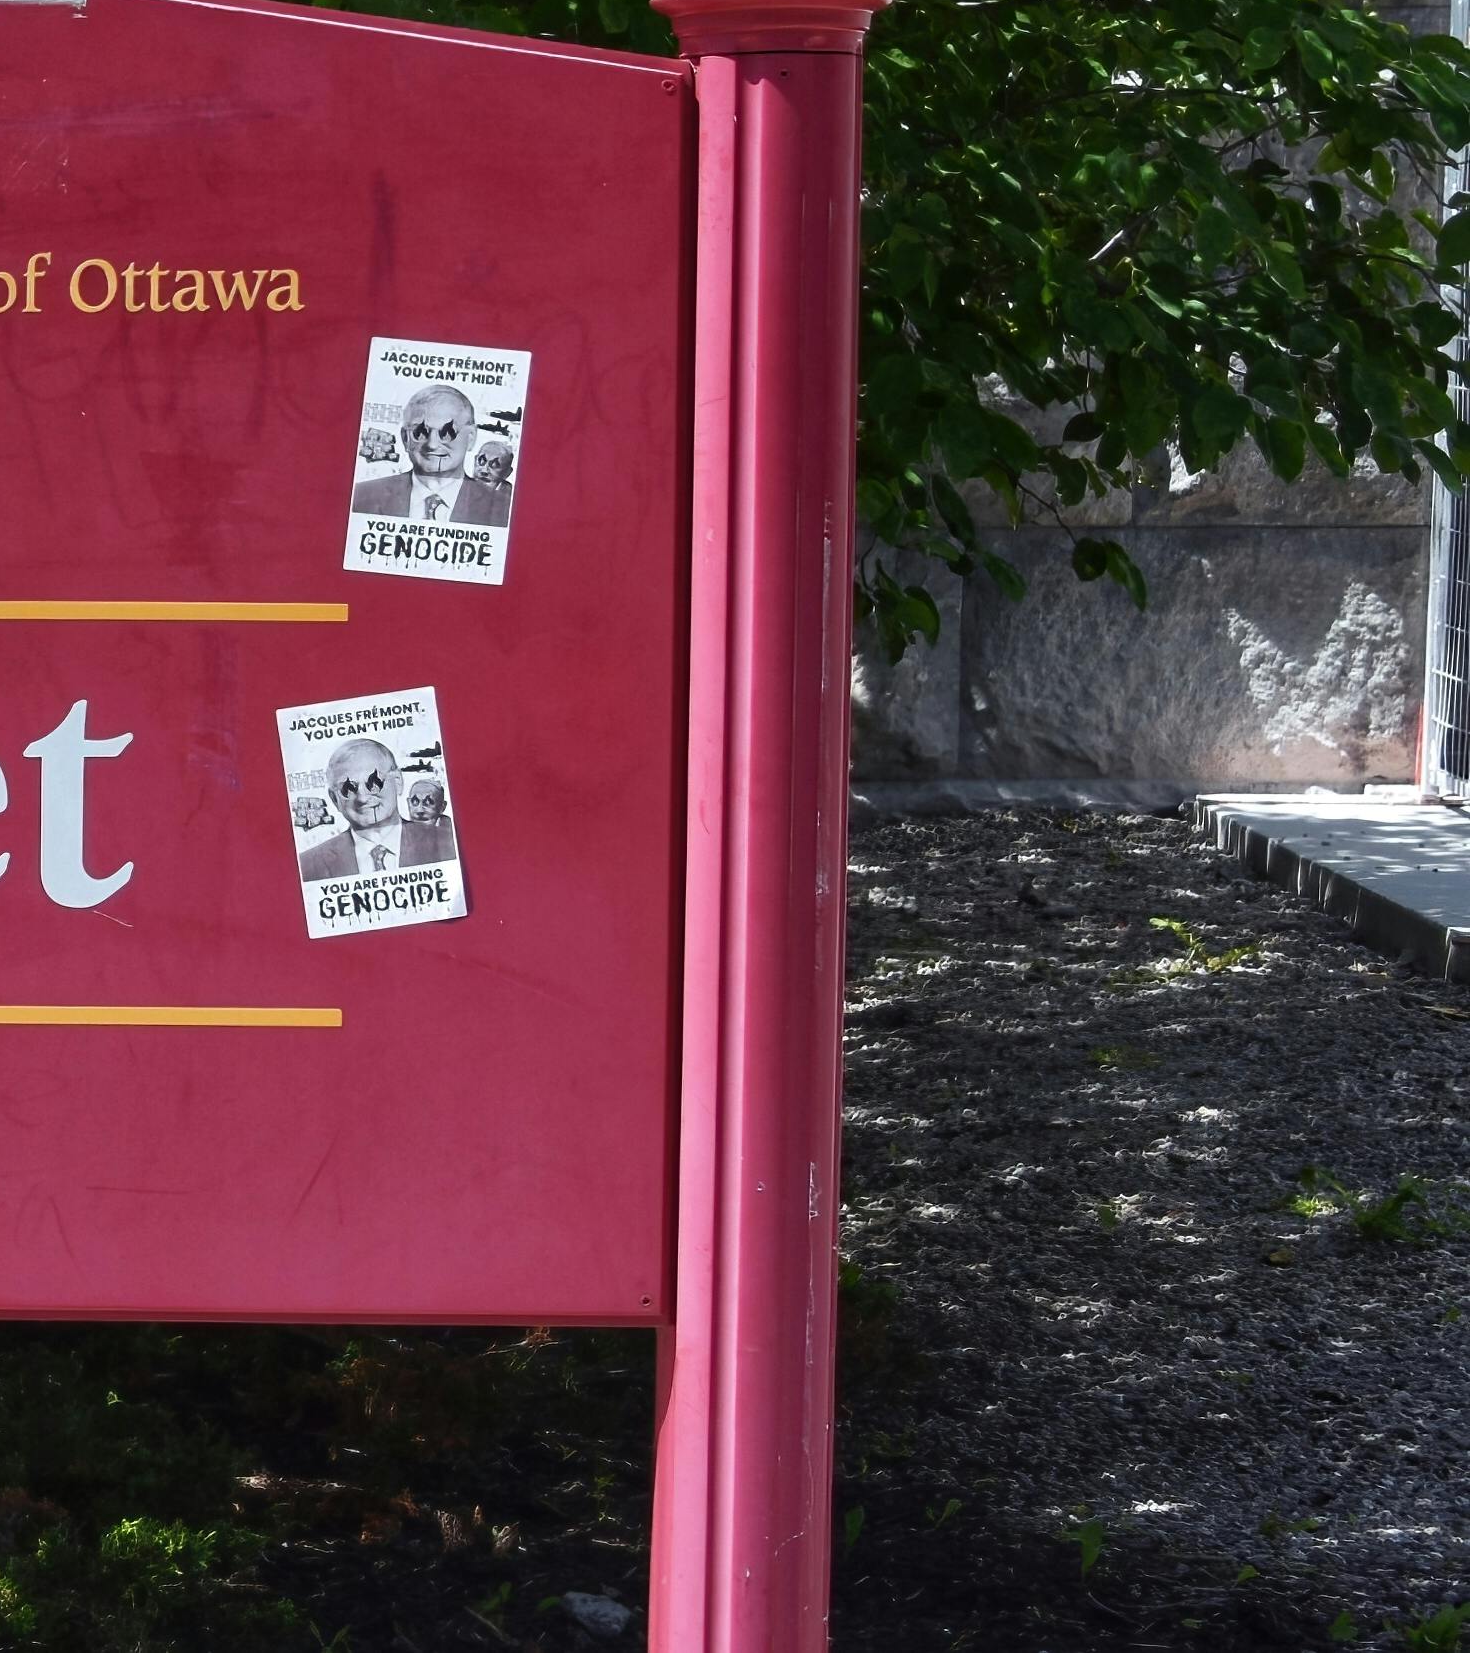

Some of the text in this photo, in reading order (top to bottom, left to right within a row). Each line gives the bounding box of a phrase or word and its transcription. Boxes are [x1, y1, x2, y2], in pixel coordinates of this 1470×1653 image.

[69, 258, 306, 313] Ottawa
[379, 350, 445, 368] JACQUES
[392, 365, 503, 386] YOU CAN'T HIDE
[365, 519, 491, 542] YOU ARE FUNDING
[358, 530, 494, 569] GENOCIDE
[288, 711, 354, 732] JACQUES
[304, 715, 414, 742] YOU CAN'T HIDE
[319, 867, 444, 896] YOU ARE FUNDING
[317, 878, 453, 922] GENOCIDE
